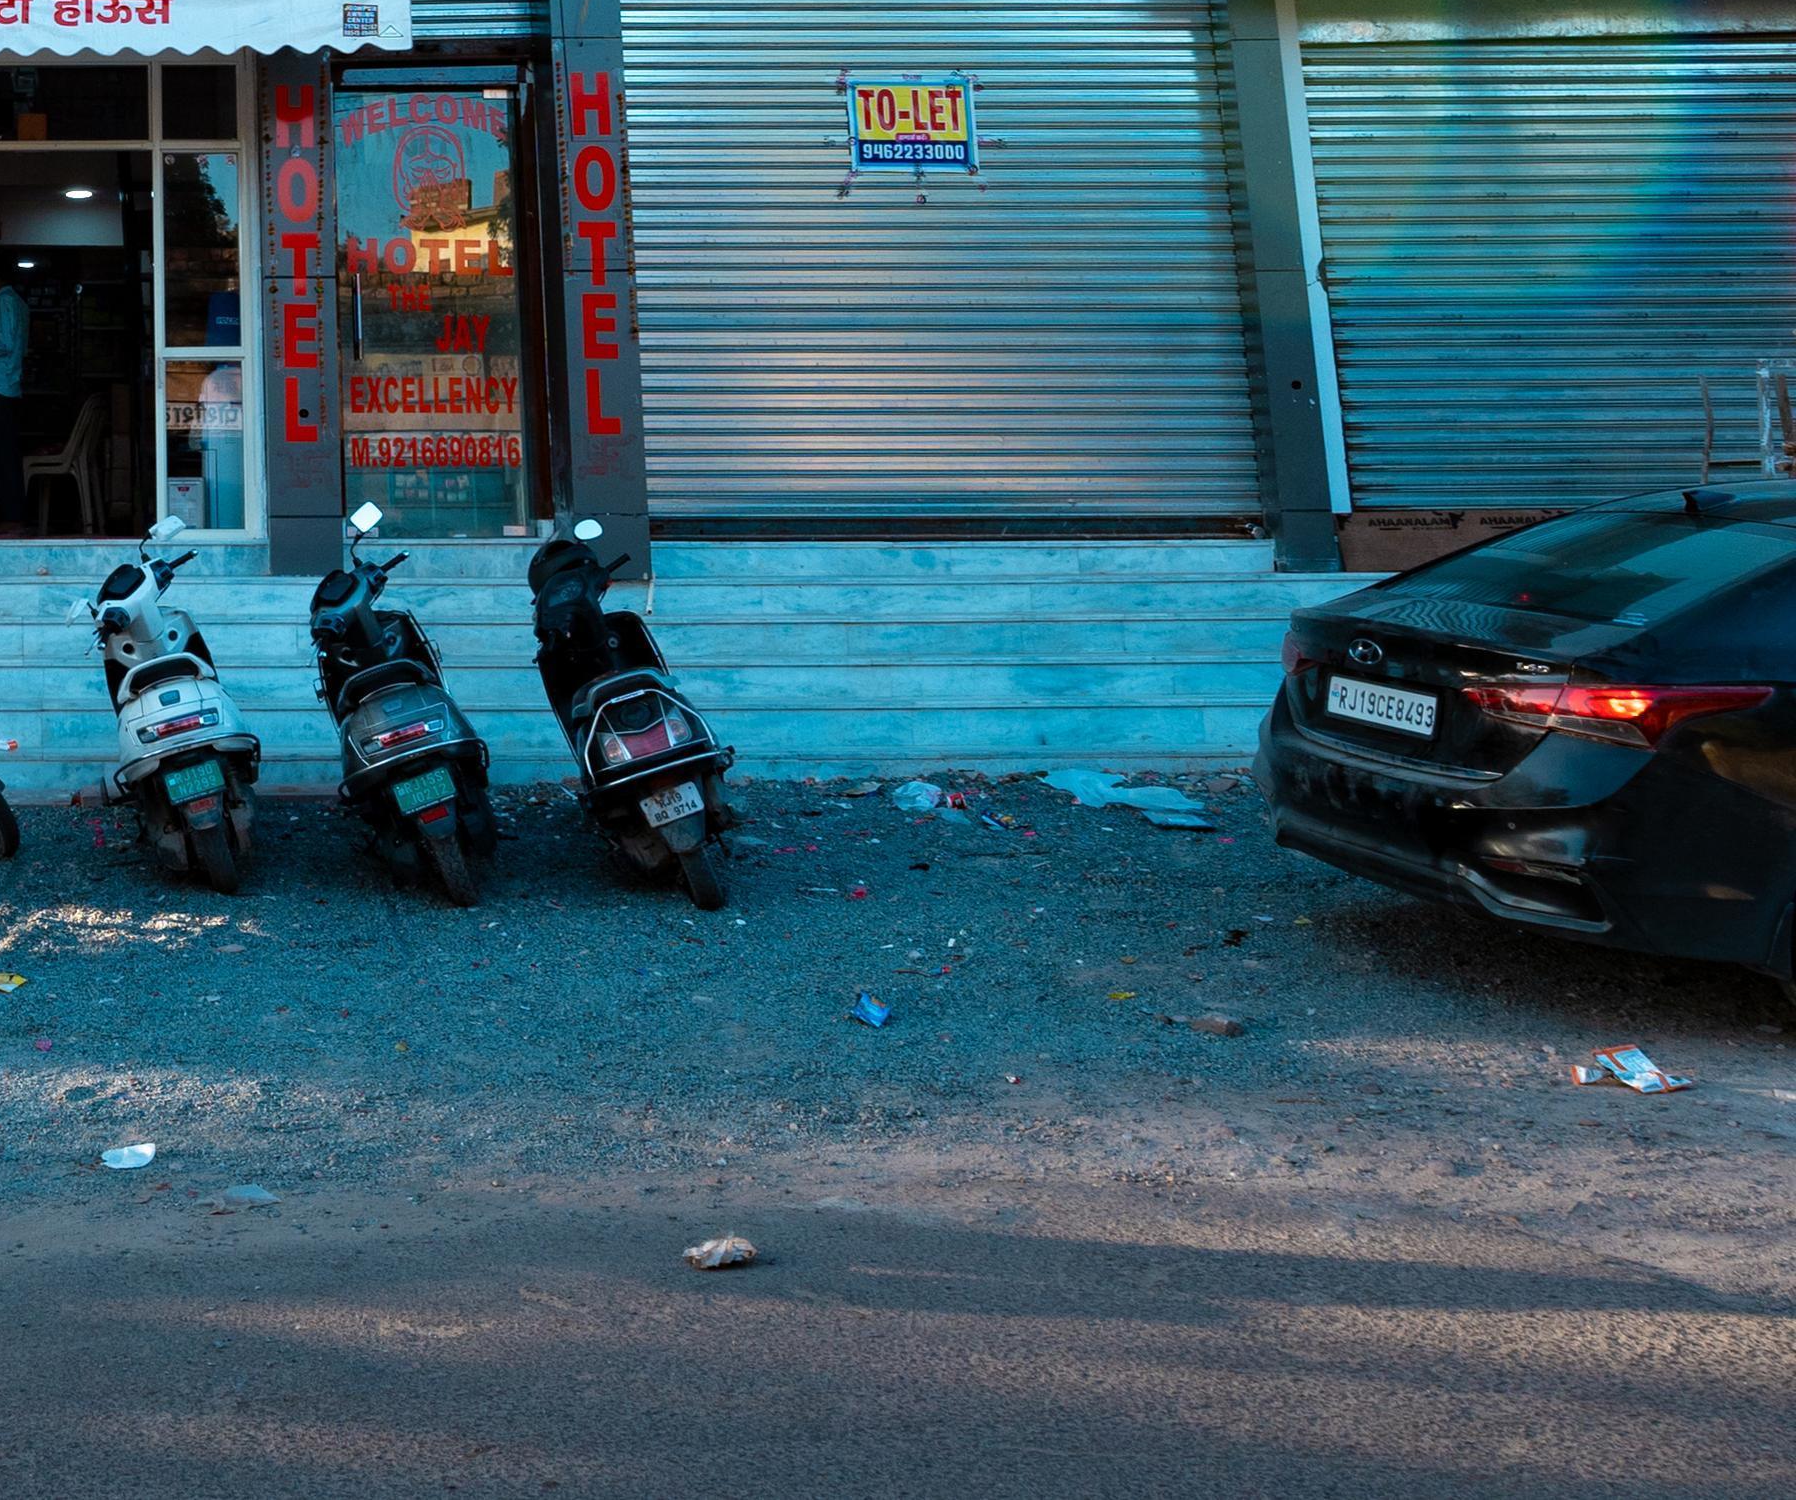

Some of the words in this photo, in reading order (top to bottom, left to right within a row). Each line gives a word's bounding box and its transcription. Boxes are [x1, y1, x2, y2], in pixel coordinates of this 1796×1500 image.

[341, 93, 507, 147] WELCOME
[857, 88, 963, 131] TO-LET
[862, 143, 965, 160] 9462233000
[275, 84, 319, 443] HOTEL
[347, 238, 513, 276] HOTEL
[570, 72, 622, 436] HOTEL
[388, 284, 431, 312] THE
[436, 315, 491, 353] JAY
[350, 376, 518, 414] EXCELLENCY
[350, 436, 521, 468] M.9216690816
[1339, 686, 1435, 728] RJ19CE8493
[673, 800, 698, 816] 9714
